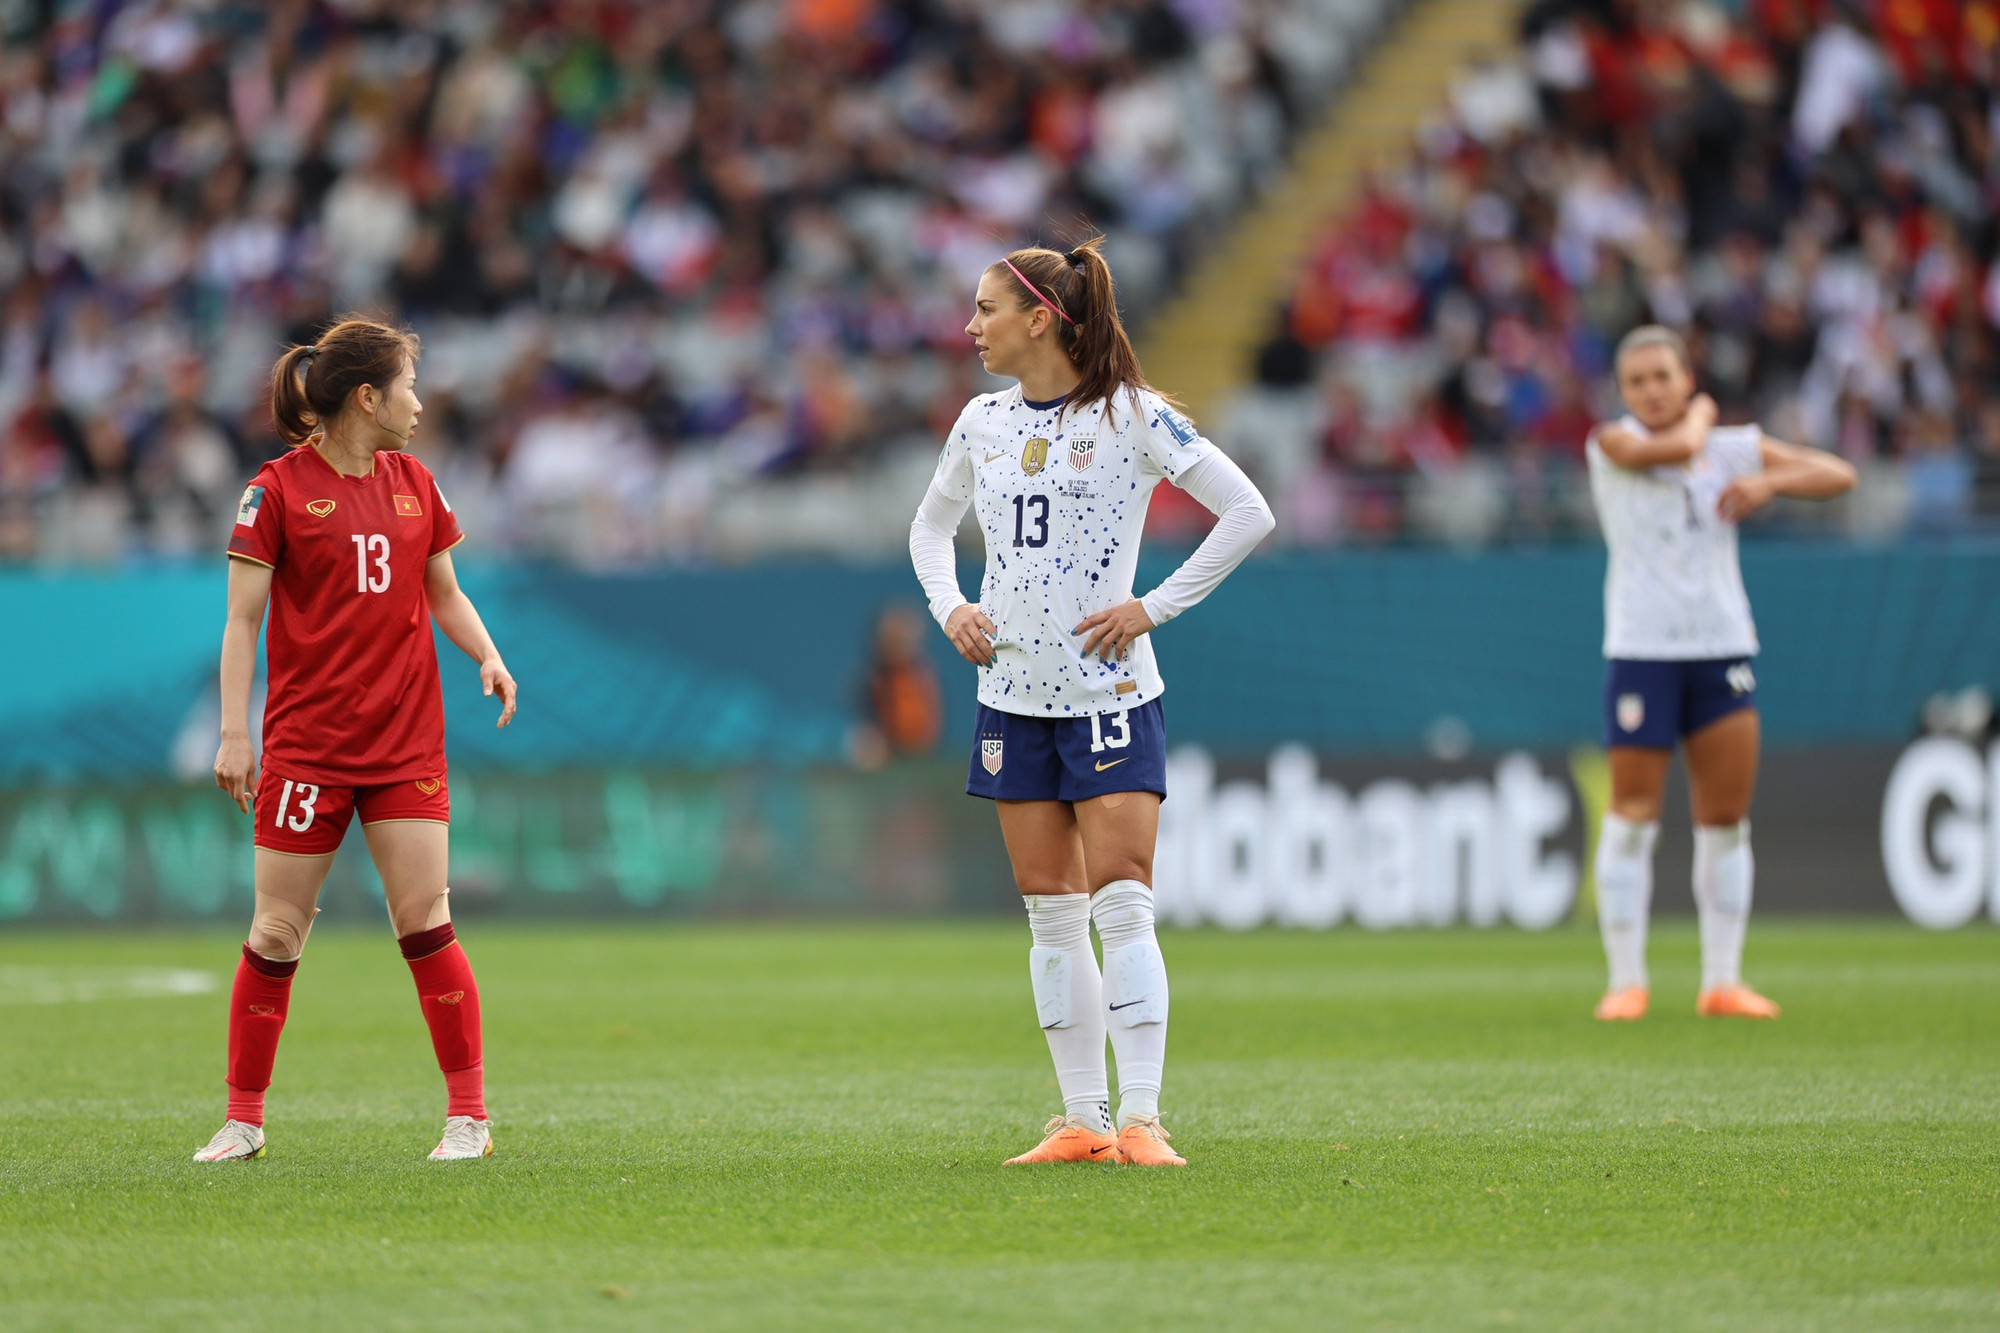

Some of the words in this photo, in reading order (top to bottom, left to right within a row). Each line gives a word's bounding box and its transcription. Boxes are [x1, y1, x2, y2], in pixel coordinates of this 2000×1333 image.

[1071, 440, 1094, 454] USA
[1012, 494, 1050, 548] 13
[351, 533, 392, 593] 13
[983, 741, 1002, 756] USA
[1090, 709, 1131, 753] 13
[275, 778, 320, 832] 13
[1152, 742, 1579, 929] lobant
